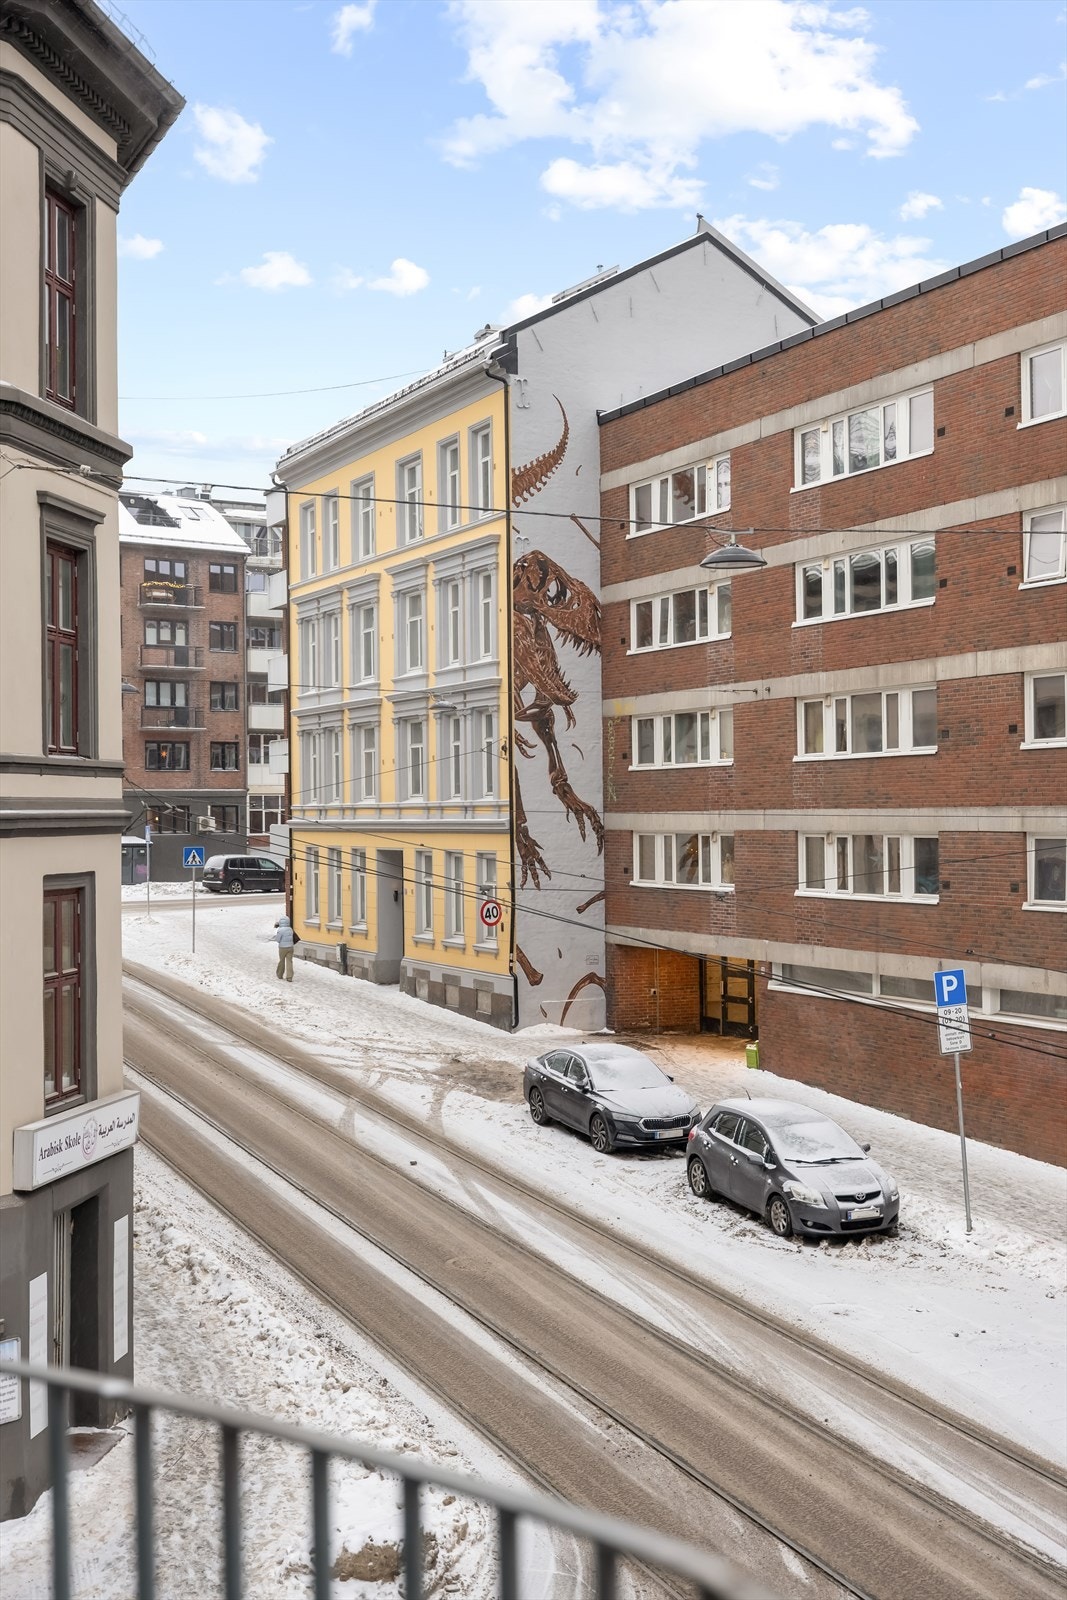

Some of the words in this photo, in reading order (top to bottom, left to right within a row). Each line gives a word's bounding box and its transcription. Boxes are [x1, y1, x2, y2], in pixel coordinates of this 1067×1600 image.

[485, 905, 499, 919] 40
[942, 975, 958, 1002] P
[944, 1007, 962, 1016] 09-20
[942, 1016, 965, 1025] (0920)
[38, 1138, 63, 1161] Arabisk
[64, 1132, 81, 1150] Skole
